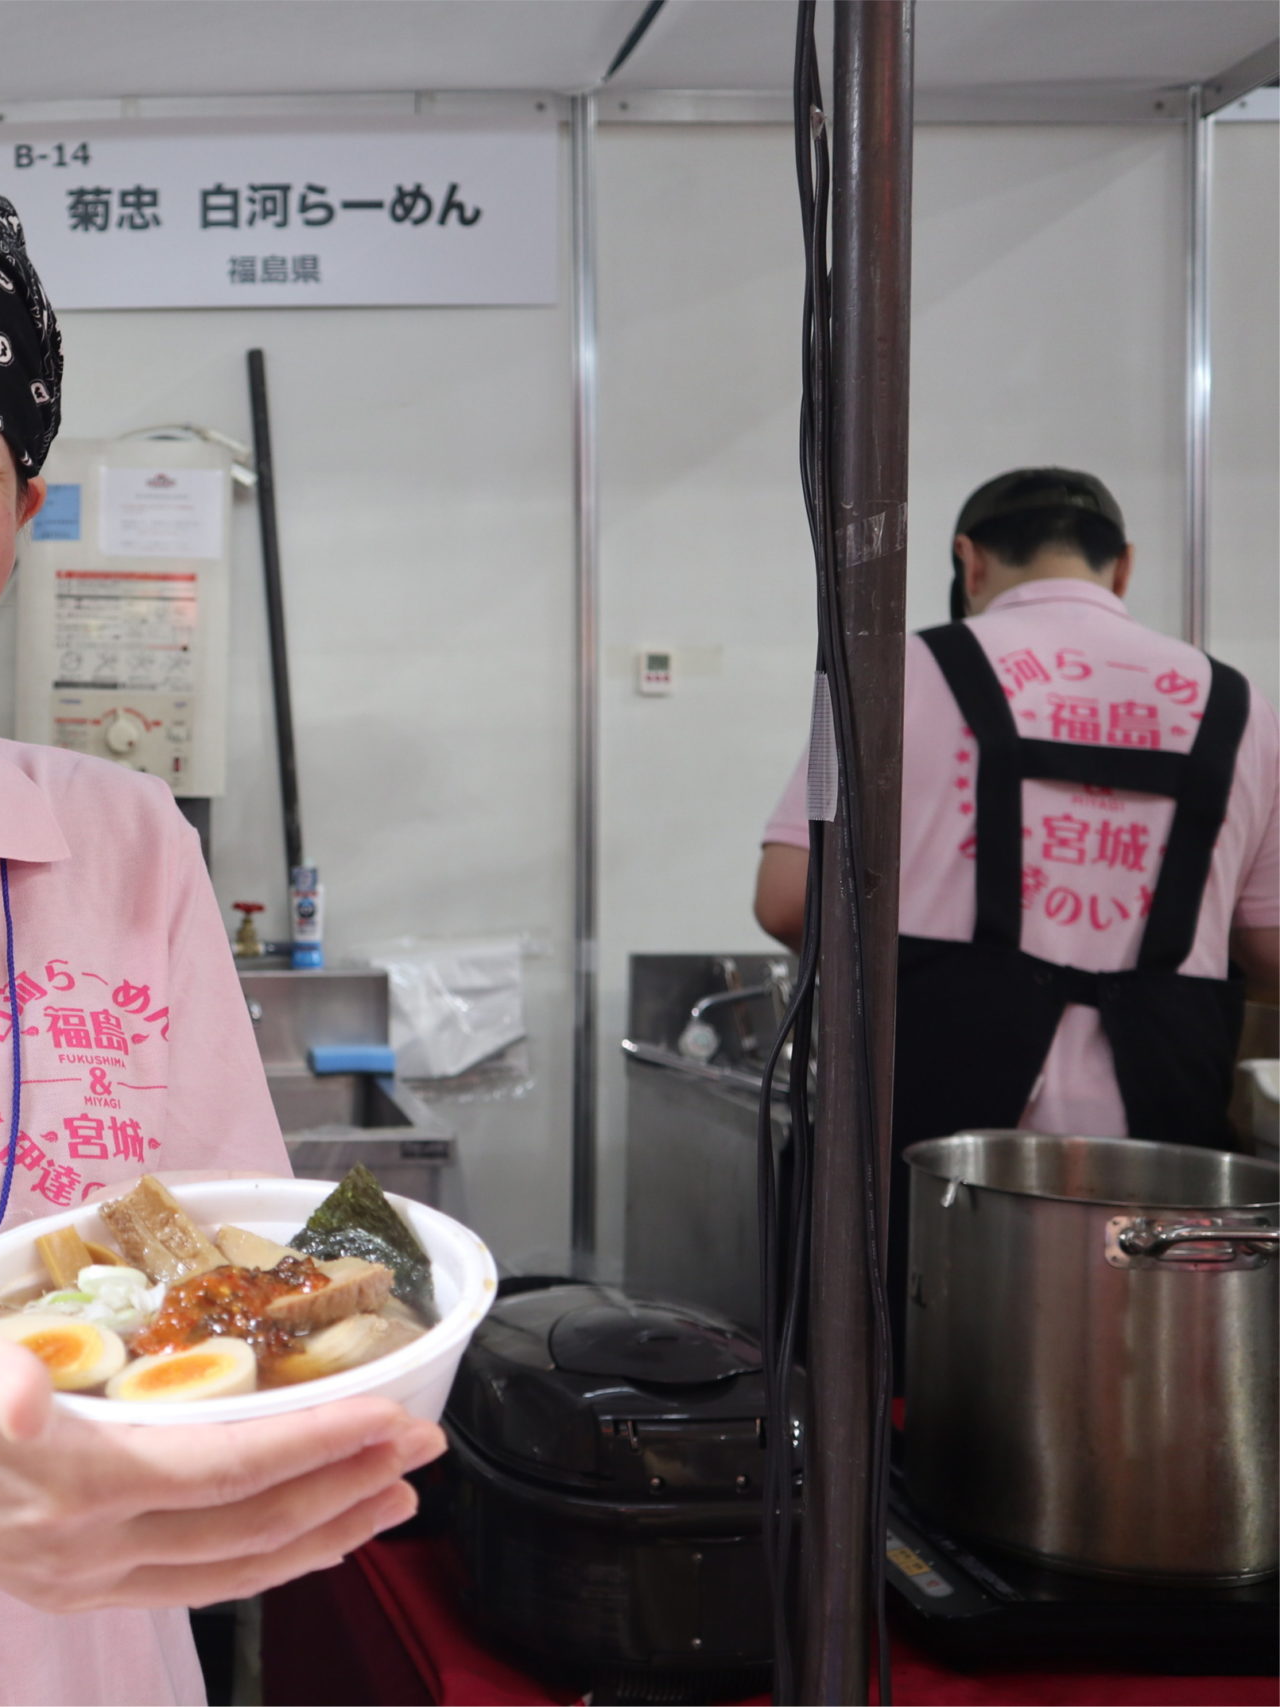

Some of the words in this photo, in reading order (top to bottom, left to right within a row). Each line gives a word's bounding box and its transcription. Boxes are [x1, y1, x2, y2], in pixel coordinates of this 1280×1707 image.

[14, 143, 91, 168] B-14
[67, 185, 161, 232] 菊忠
[199, 183, 482, 230] 白河らーめん
[229, 255, 321, 284] 福島県
[999, 648, 1204, 720] 河らーめ
[1046, 693, 1161, 750] 福島
[1042, 813, 1149, 873] 宮城
[44, 1005, 128, 1055] 福島
[84, 1096, 121, 1110] MIYAGI
[89, 1067, 112, 1096] &
[63, 1113, 145, 1163] 宮城
